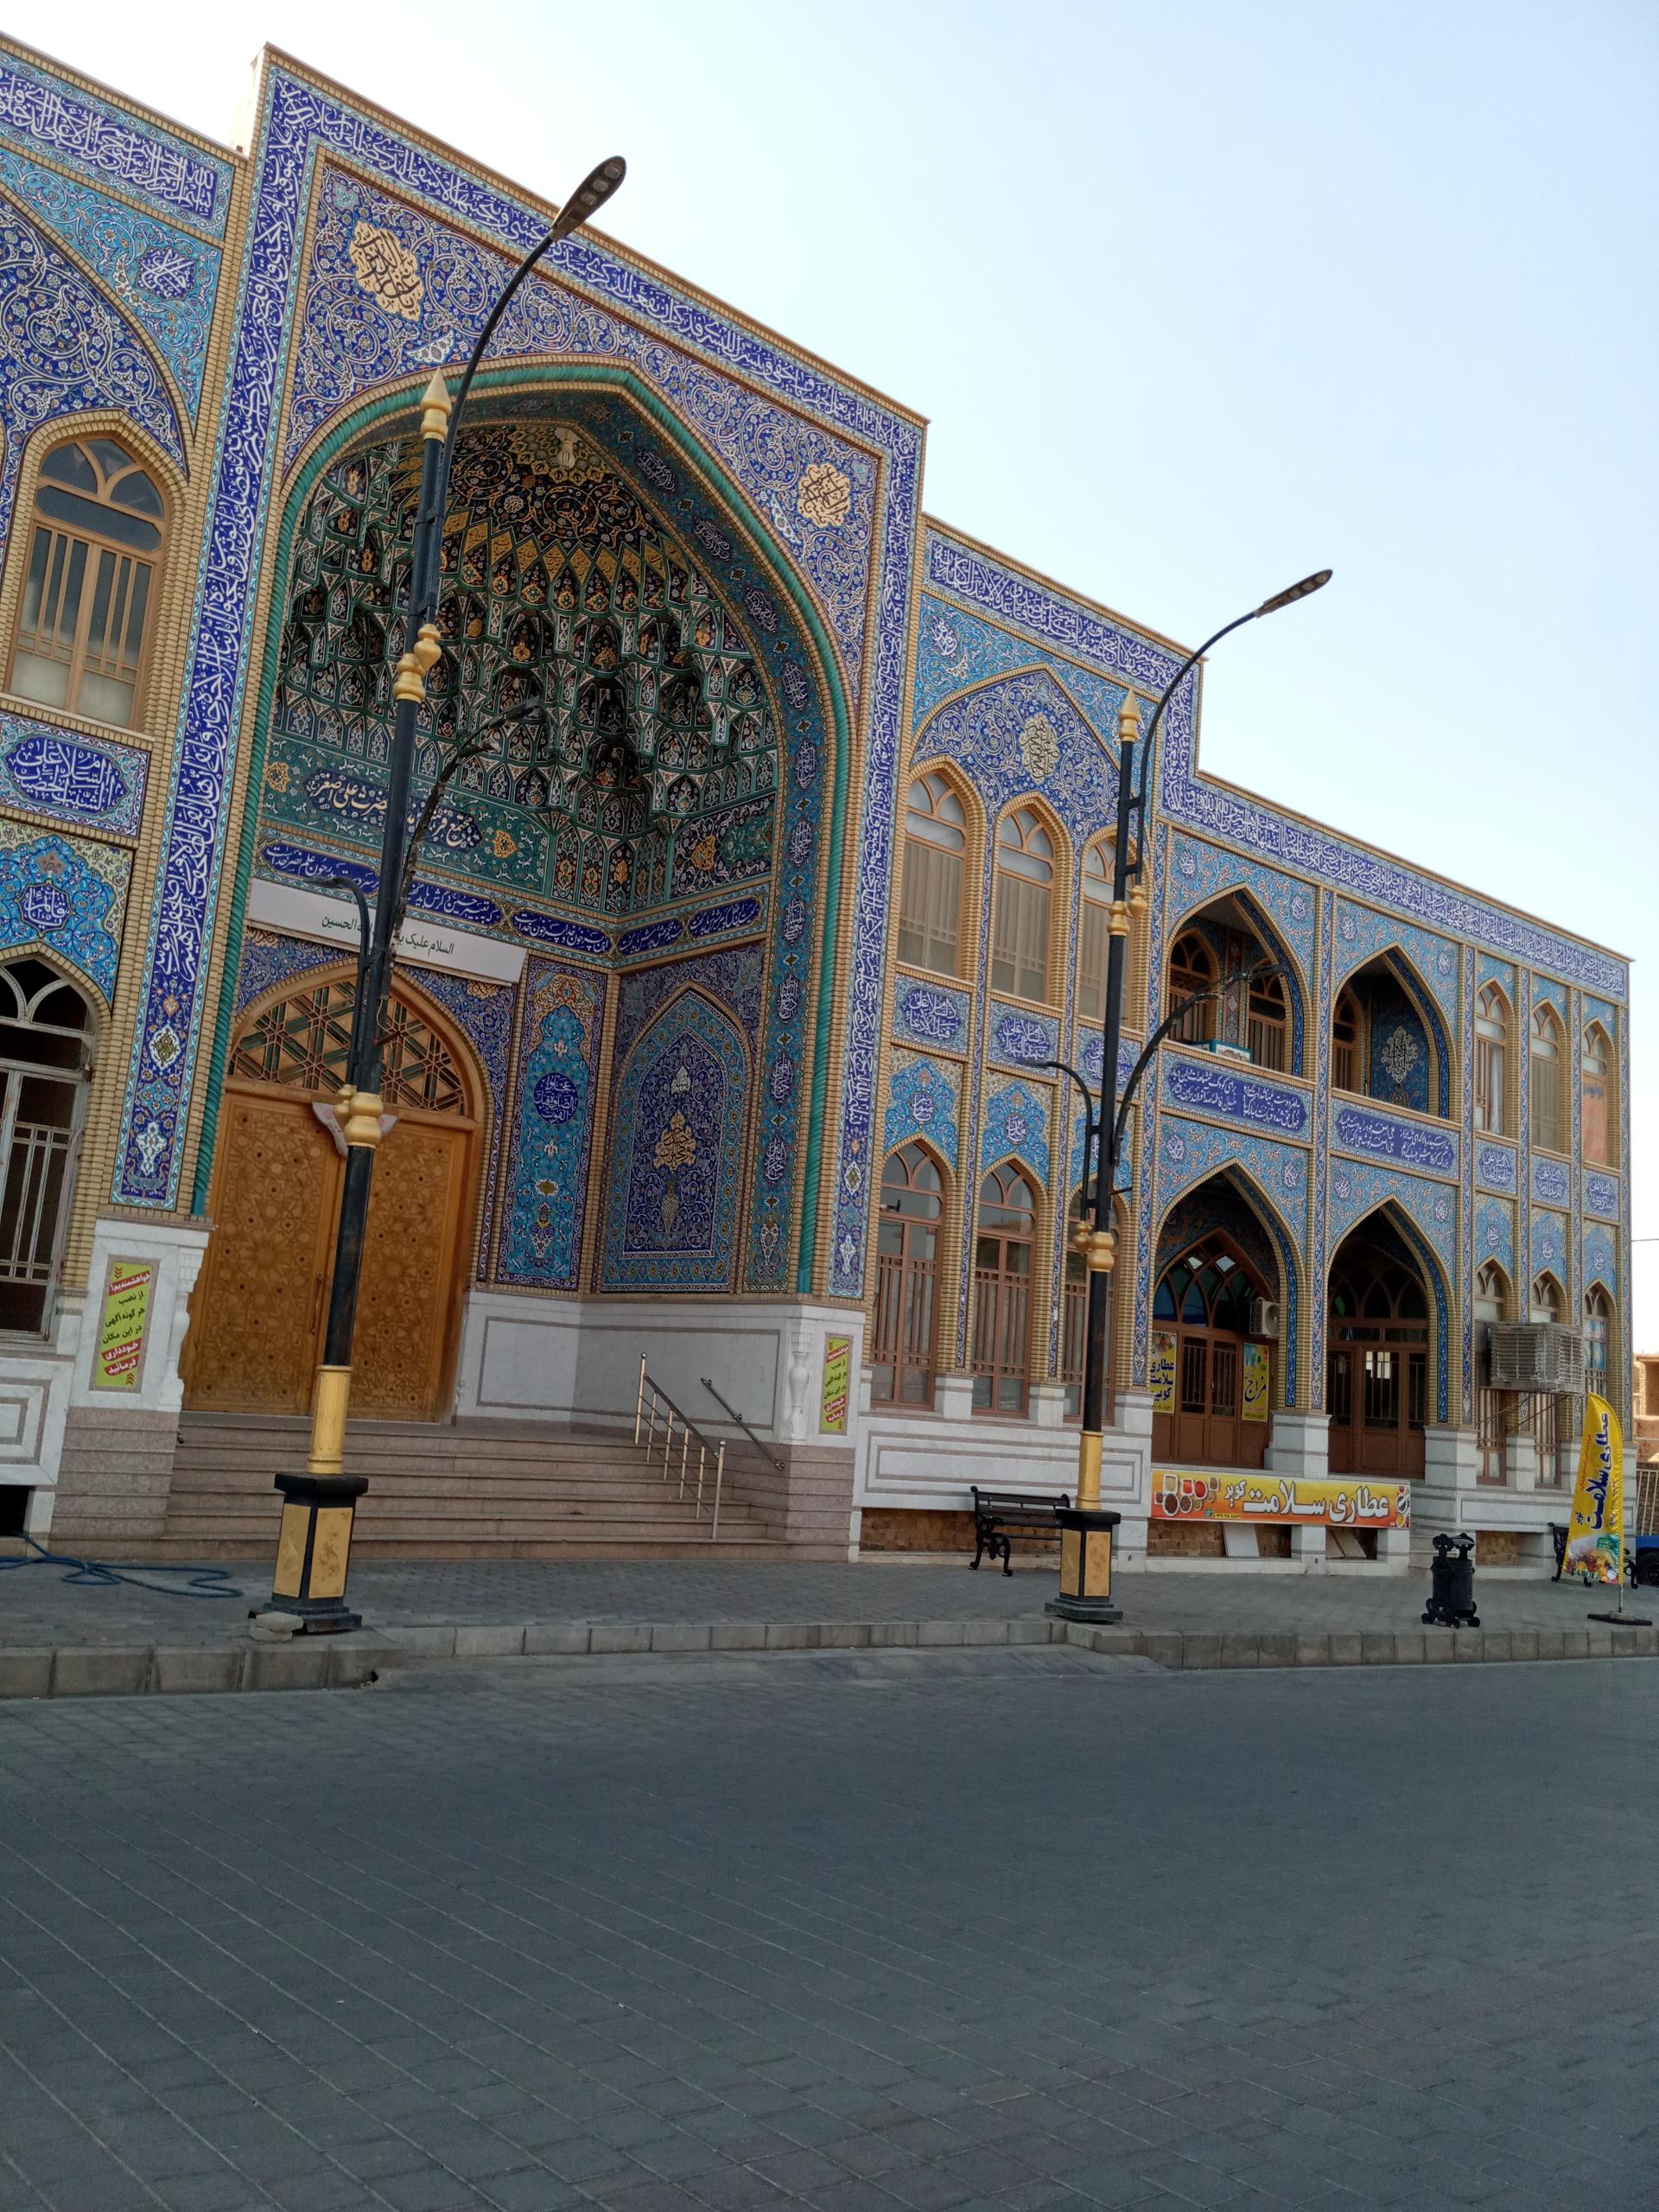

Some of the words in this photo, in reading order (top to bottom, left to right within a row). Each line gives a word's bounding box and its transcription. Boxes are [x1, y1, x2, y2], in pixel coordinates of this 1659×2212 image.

[321, 914, 357, 934] الحسین
[428, 942, 454, 957] السلام
[118, 1294, 138, 1306] نصب
[102, 1332, 120, 1344] مکان
[122, 1326, 133, 1338] این
[105, 1341, 139, 1361] خودداری
[1150, 1358, 1174, 1373] عطاری
[1150, 1373, 1173, 1385] سلامت
[1595, 1412, 1612, 1470] عطاری
[1223, 1479, 1247, 1508] کویر
[1242, 1478, 1327, 1516] سلامت
[1586, 1467, 1611, 1530] سلامت
[1329, 1485, 1390, 1523] عطاری
